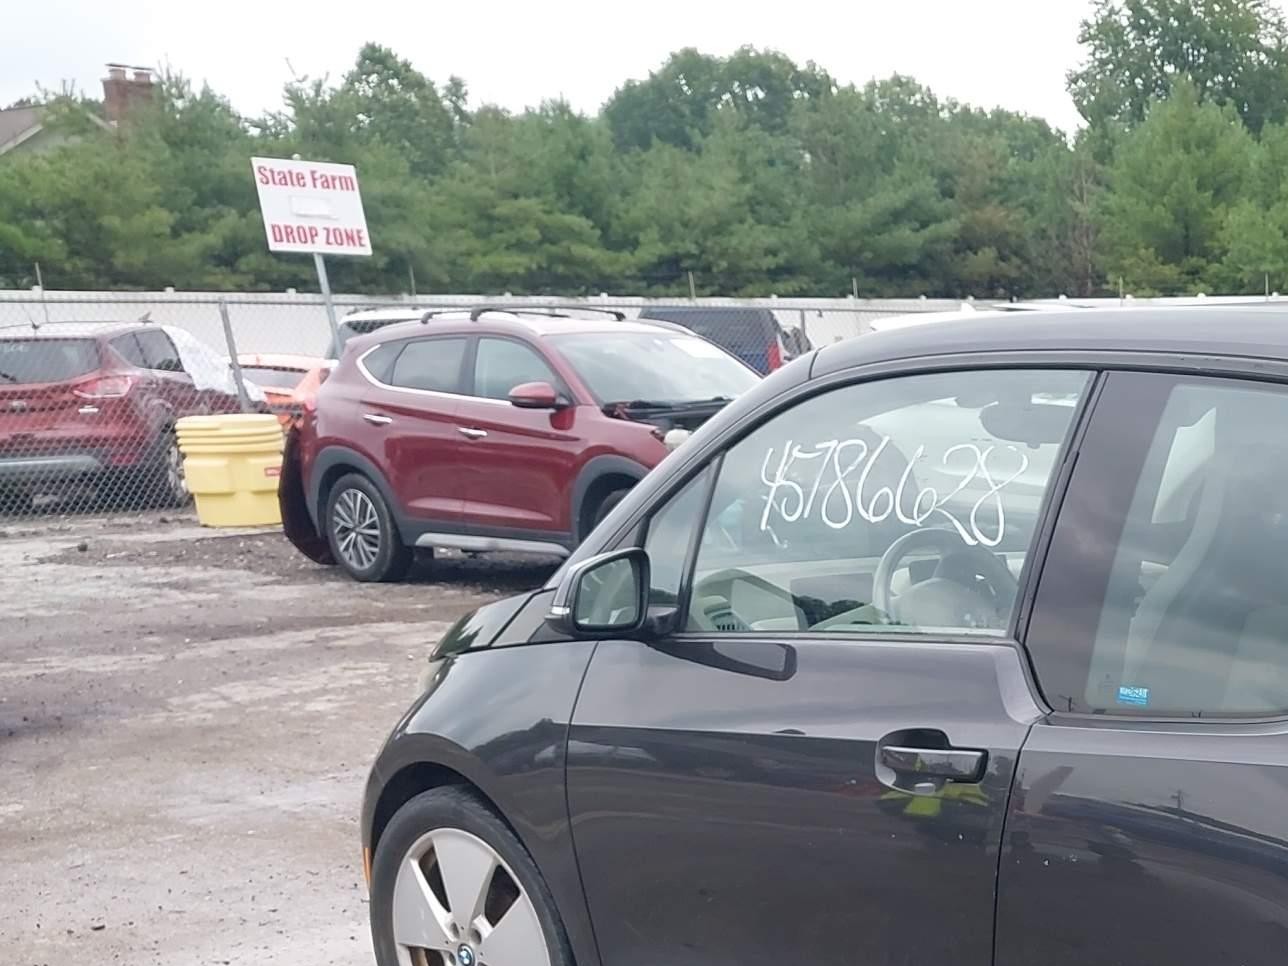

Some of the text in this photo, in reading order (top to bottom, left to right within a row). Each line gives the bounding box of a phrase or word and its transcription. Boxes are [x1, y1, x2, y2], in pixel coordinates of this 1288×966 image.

[257, 165, 355, 192] State Farm
[271, 223, 366, 248] DROP ZONE
[760, 435, 1029, 547] 45786628
